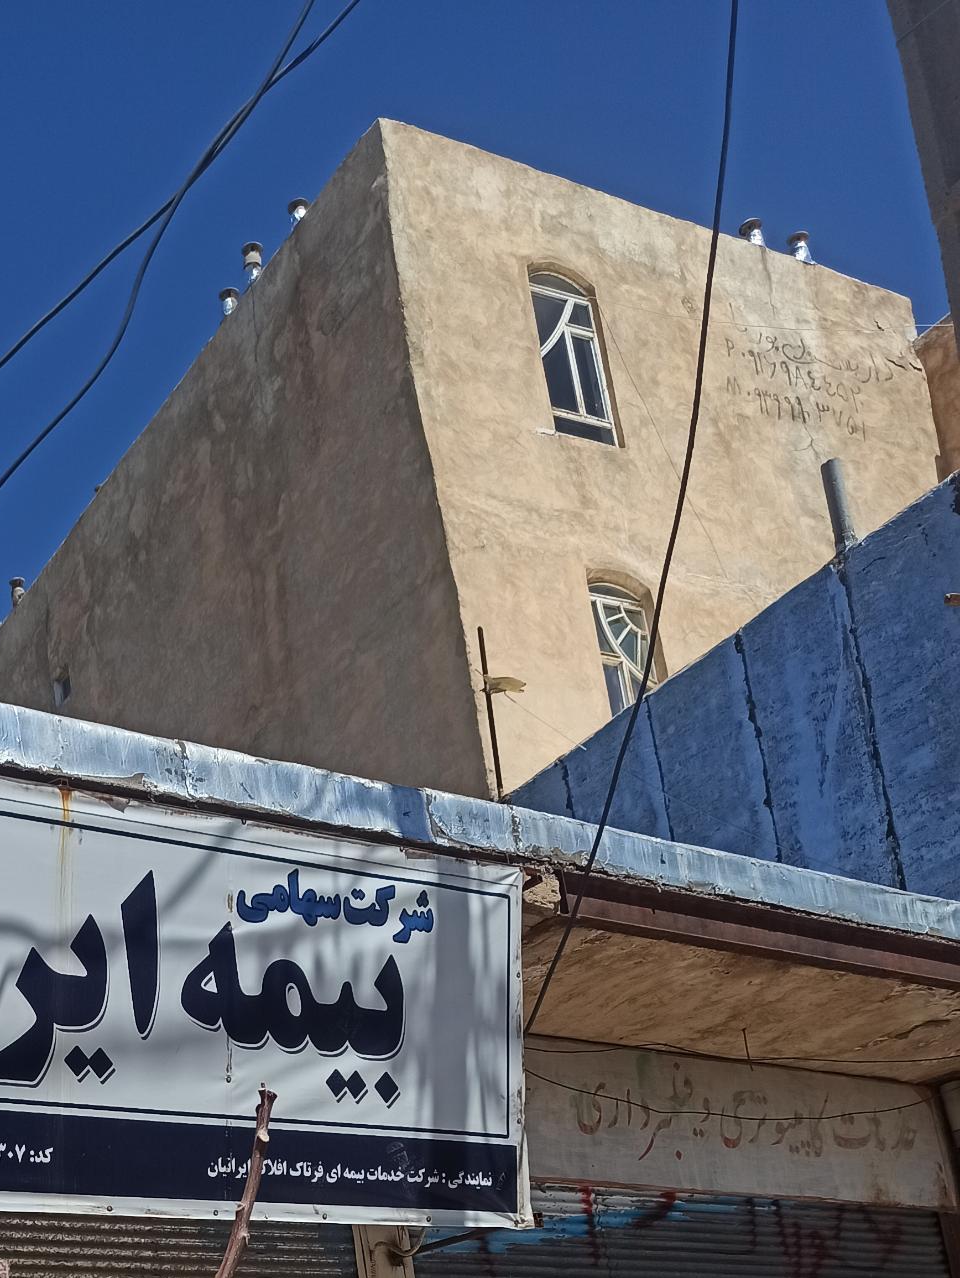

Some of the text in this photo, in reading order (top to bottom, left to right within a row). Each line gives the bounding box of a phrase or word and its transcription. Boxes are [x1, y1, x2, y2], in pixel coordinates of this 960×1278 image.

[236, 868, 435, 944] شرکت سهامی
[180, 920, 406, 1108] بیمه
[207, 1156, 251, 1178] ایرانیان
[289, 1160, 324, 1183] فرتاک
[326, 1162, 342, 1183] ای
[343, 1166, 365, 1184] بیمه
[366, 1165, 405, 1182] خدمات
[407, 1167, 440, 1188] شرکت
[447, 1170, 494, 1189] نمایندگی
